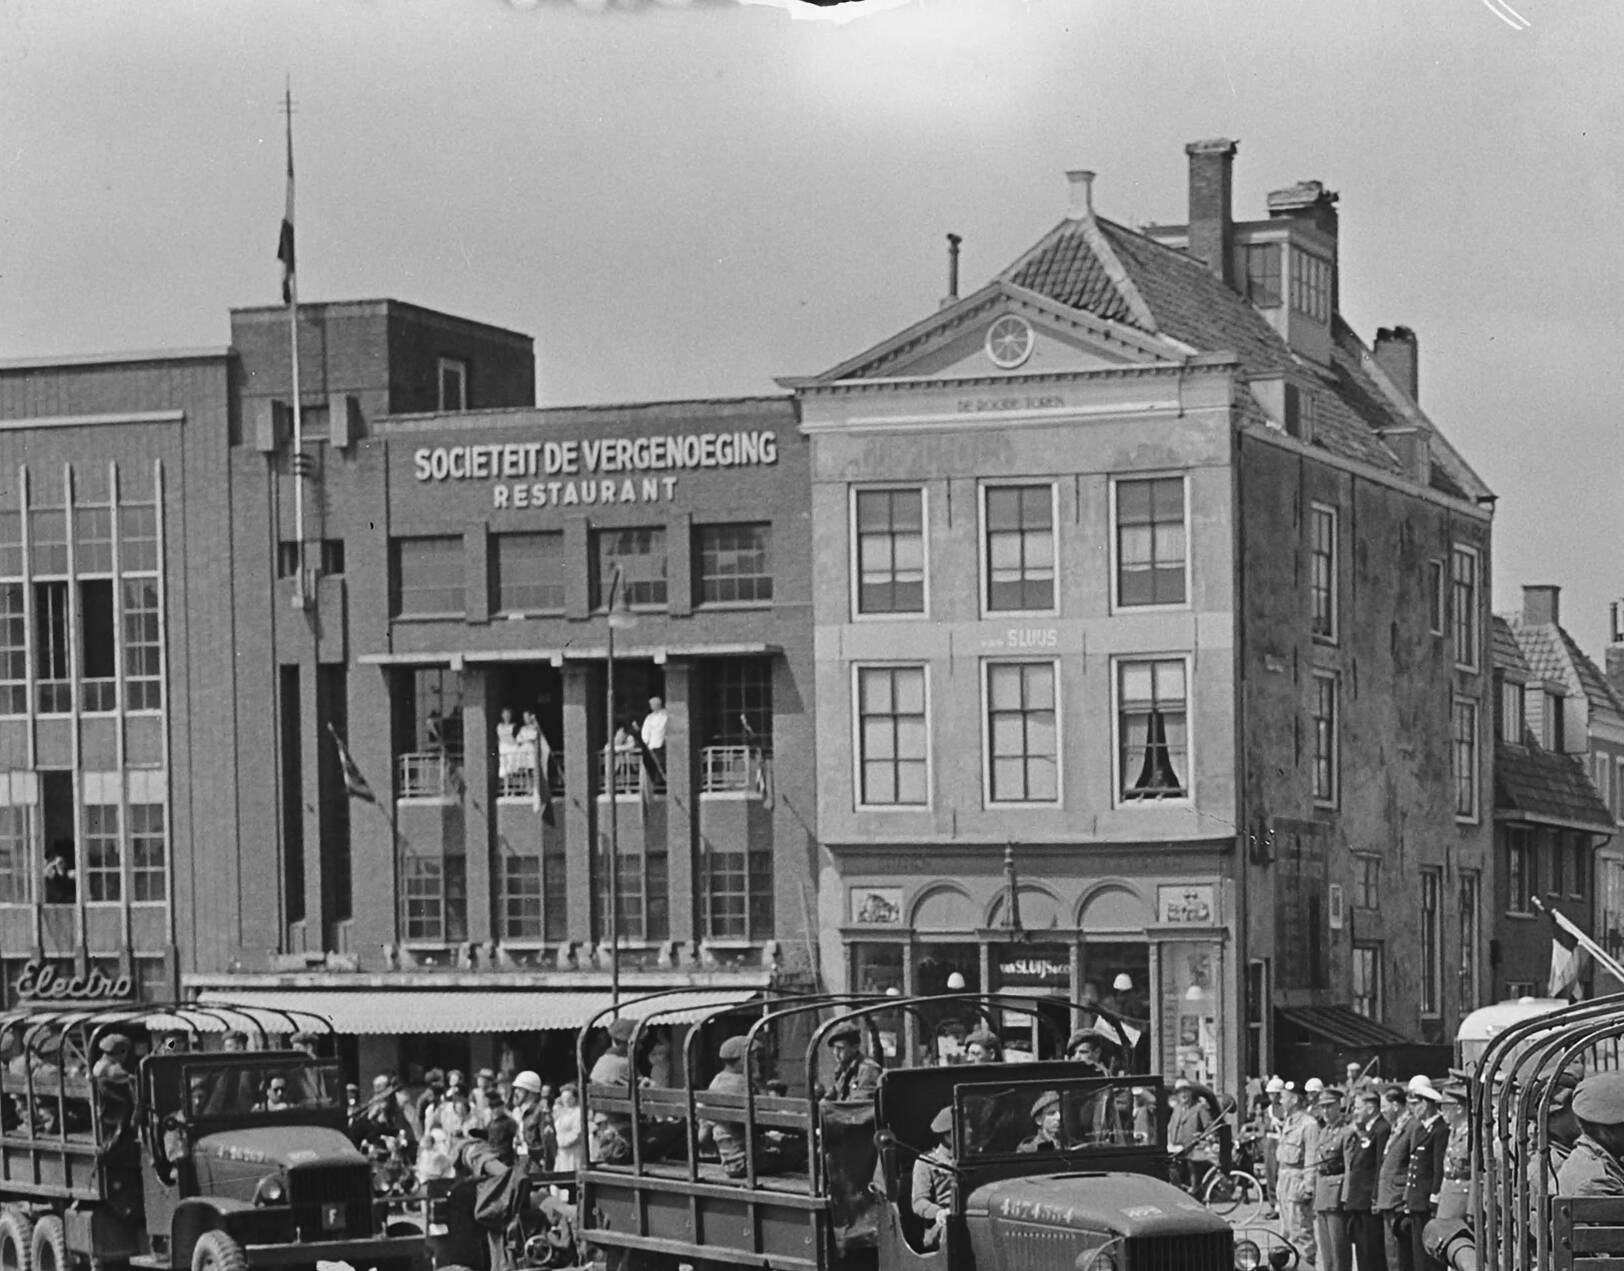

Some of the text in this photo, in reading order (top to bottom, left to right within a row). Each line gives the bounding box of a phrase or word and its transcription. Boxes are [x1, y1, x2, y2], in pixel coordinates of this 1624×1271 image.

[414, 431, 777, 480] SOCIETEIT DE VERGENOEGING
[493, 476, 678, 508] RESTAURANT
[15, 958, 133, 998] Electro
[329, 1208, 338, 1225] F
